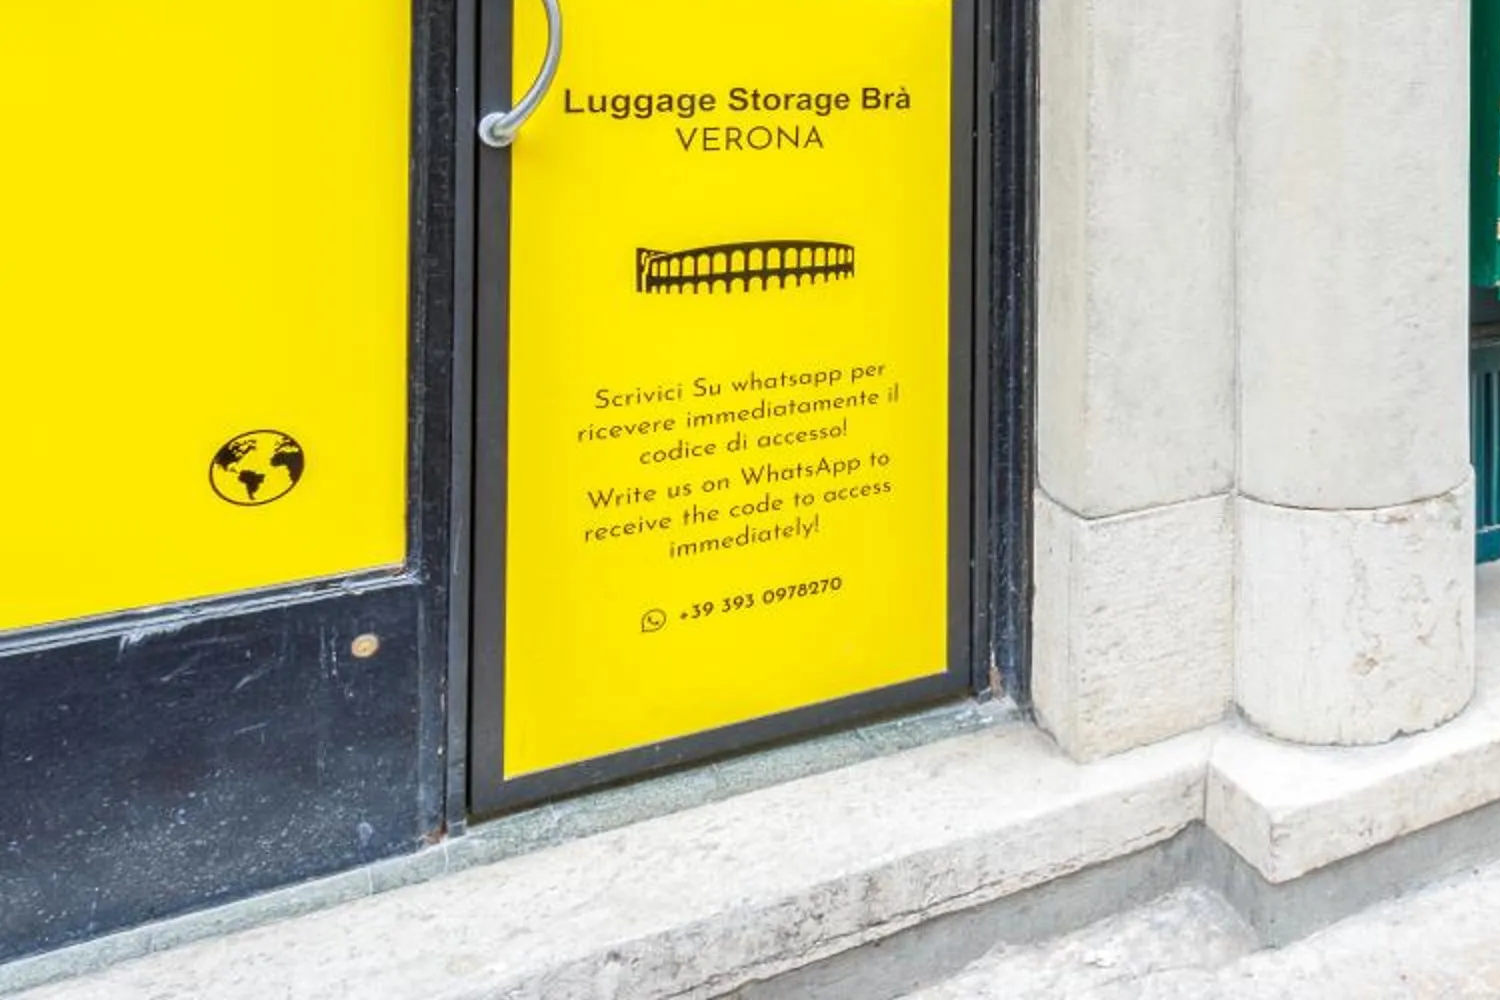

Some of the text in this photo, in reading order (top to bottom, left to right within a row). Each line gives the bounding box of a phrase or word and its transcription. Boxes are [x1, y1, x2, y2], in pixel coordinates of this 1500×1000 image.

[564, 87, 911, 120] Luggage Storage Brà
[676, 125, 824, 152] VERONA
[595, 364, 885, 408] Scrivici Su whatsapp per
[578, 382, 899, 442] ricevere immediatamente il
[640, 418, 846, 464] codice di accesso!
[588, 452, 891, 509] Write us on WhatsApp to
[585, 482, 891, 542] receive the code to access
[670, 514, 819, 558] immediately!
[679, 576, 842, 621] +39 393 0978270
